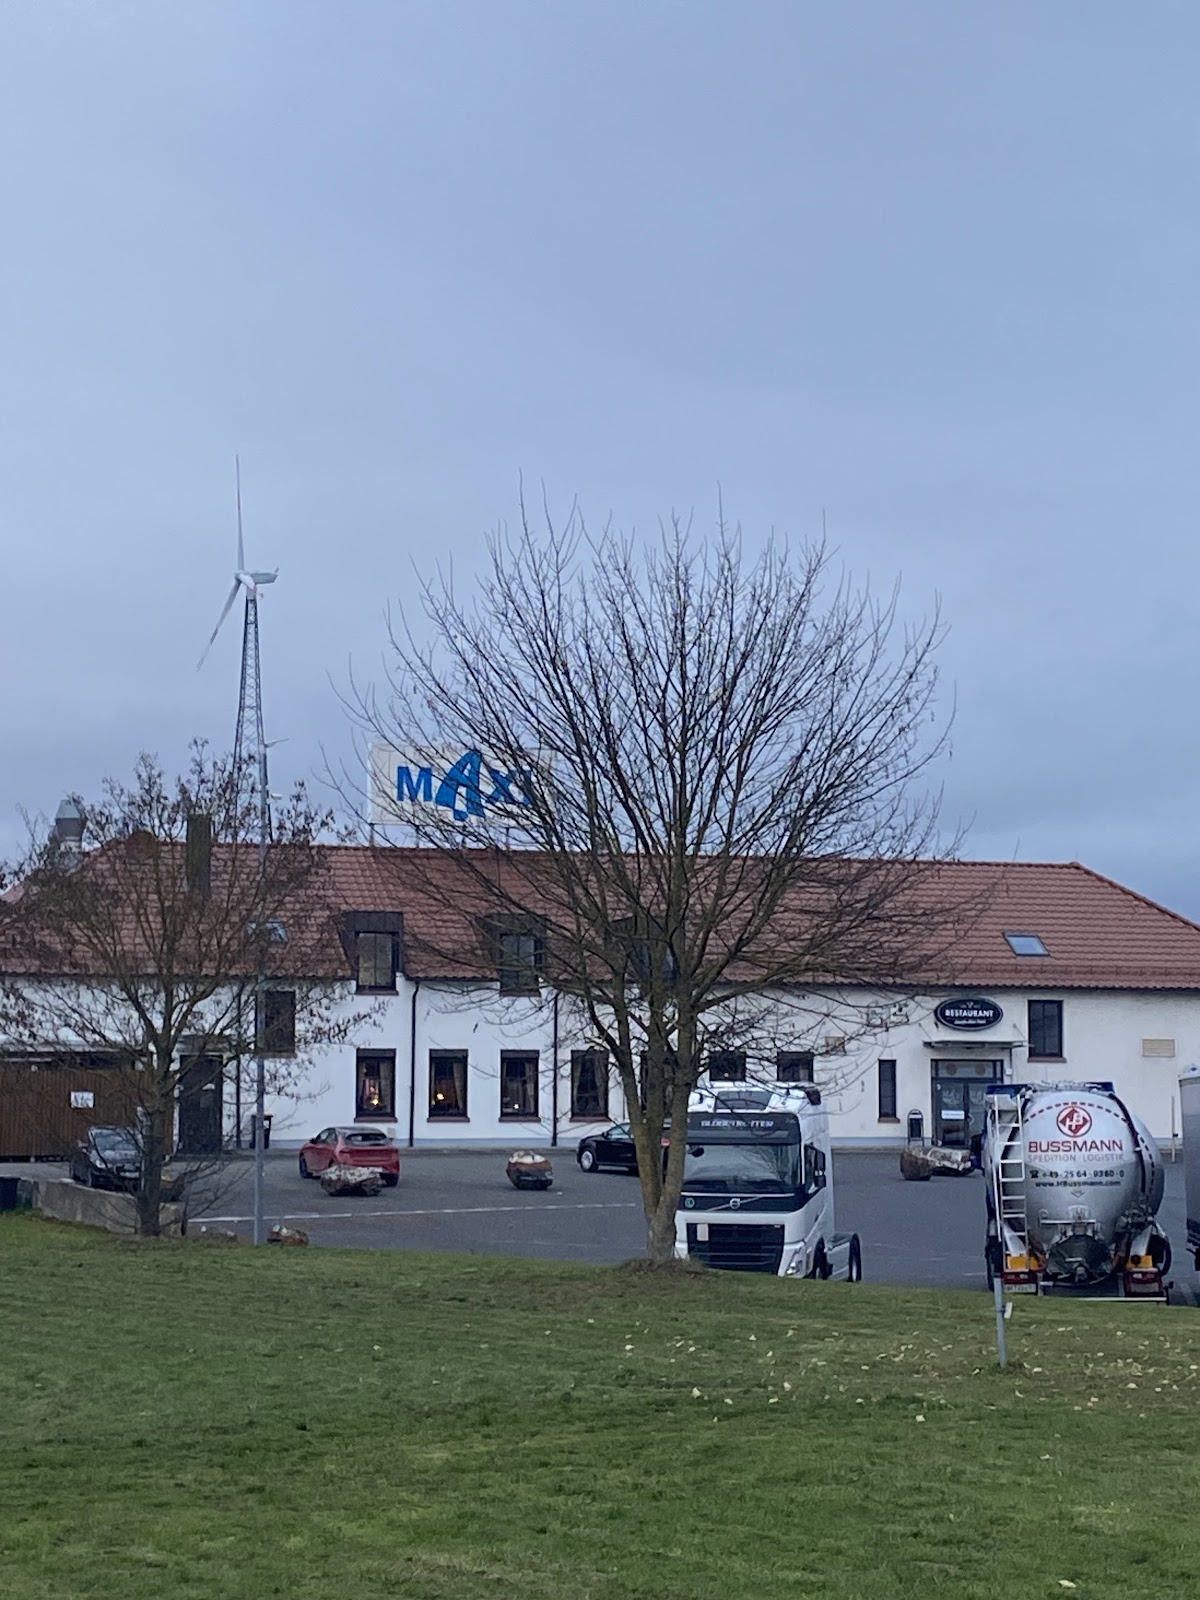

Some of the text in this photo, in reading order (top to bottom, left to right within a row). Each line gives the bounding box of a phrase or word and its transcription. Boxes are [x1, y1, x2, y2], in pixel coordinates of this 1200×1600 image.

[945, 1009, 994, 1017] RESTAURANT
[1028, 1139, 1123, 1153] BUSSMANN
[1028, 1153, 1125, 1163] SPEDITION LOGISTIK
